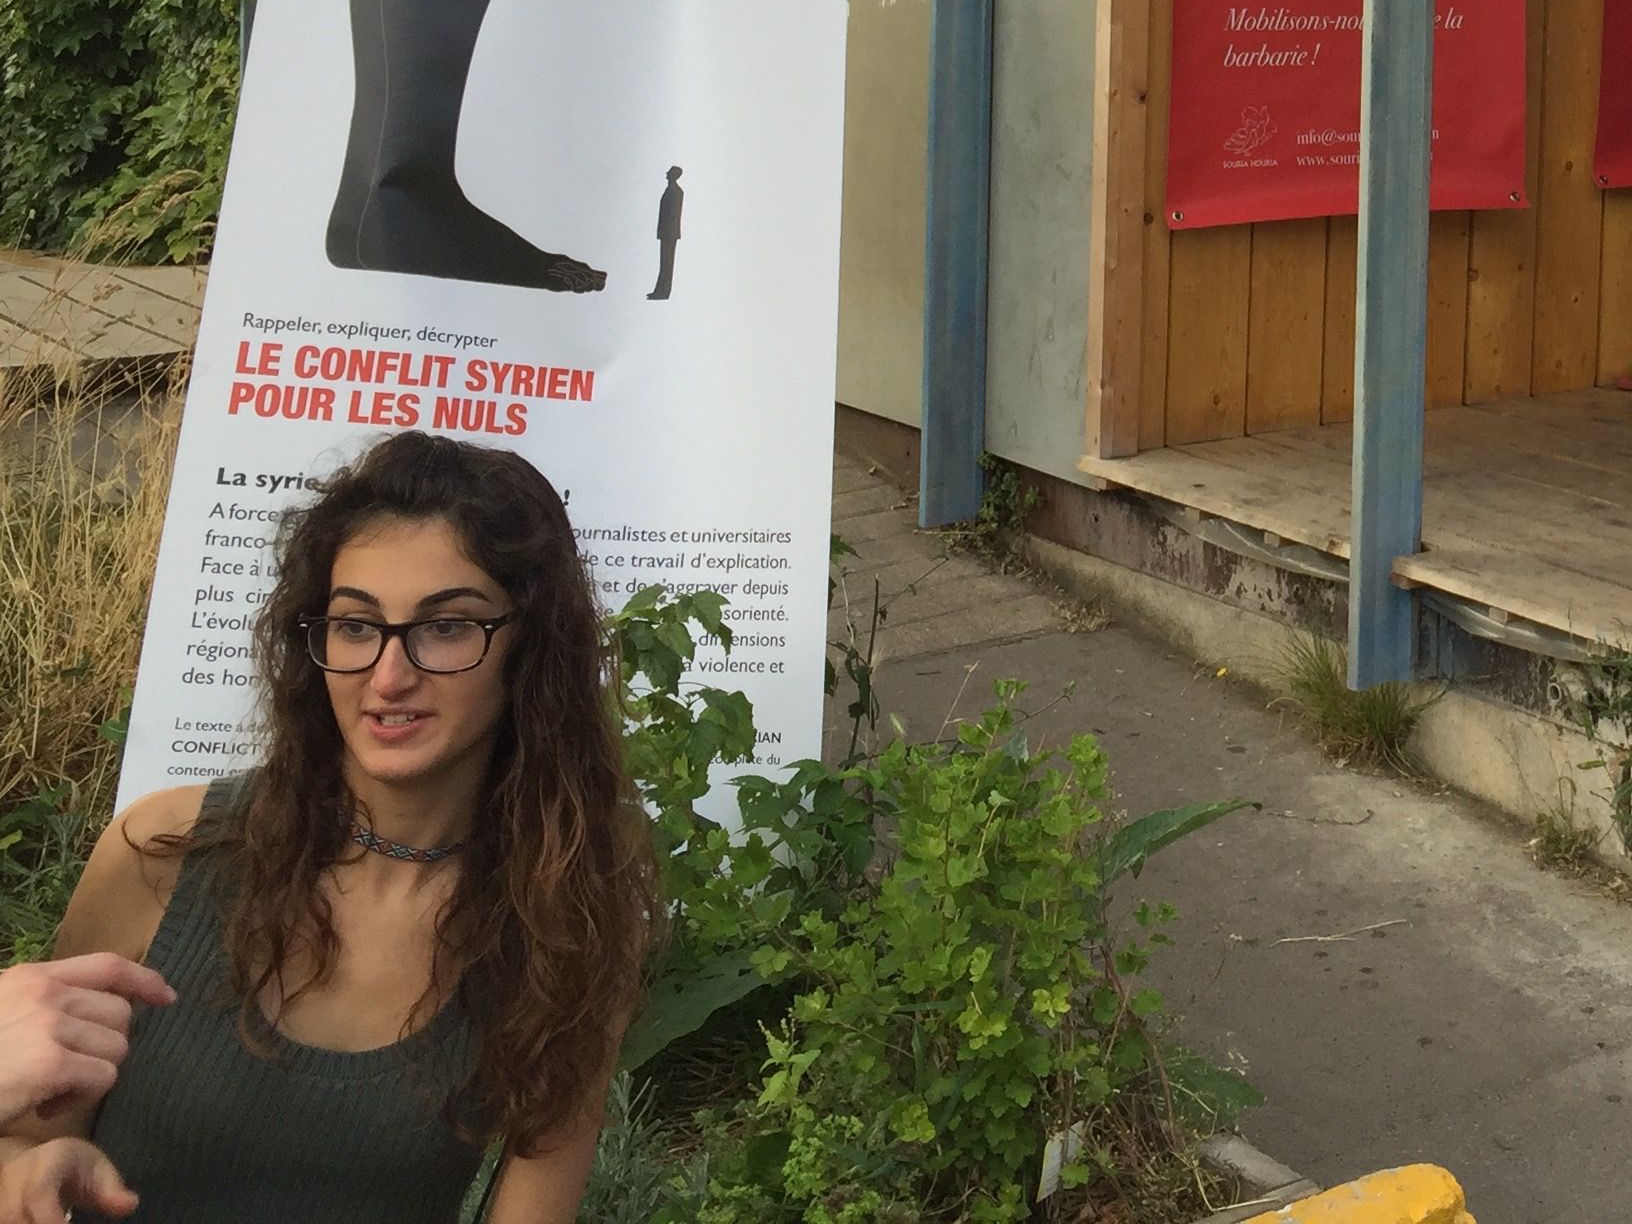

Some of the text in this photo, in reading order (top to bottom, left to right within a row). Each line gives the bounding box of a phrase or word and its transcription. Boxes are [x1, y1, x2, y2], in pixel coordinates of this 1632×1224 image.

[1444, 7, 1463, 30] la
[1223, 43, 1308, 67] barbarie
[243, 312, 498, 351] Rappeler, expliquer, décrypter
[235, 341, 595, 402] LE CONFLIT SYRIEN
[227, 382, 528, 436] POUR LES NULS
[216, 467, 247, 486] La
[255, 472, 318, 494] syrie
[208, 502, 792, 544] A force ournalistes et universitaires
[205, 529, 275, 549] franco-
[604, 554, 624, 567] ce
[631, 553, 684, 569] travail
[690, 553, 791, 573] d'explication.
[200, 556, 244, 575] Face
[249, 560, 260, 577] à
[602, 581, 619, 593] et
[743, 580, 789, 599] depuis
[195, 584, 234, 605] plus
[723, 606, 789, 621] sorienté.
[182, 667, 215, 684] des
[699, 657, 765, 673] violence
[769, 661, 785, 673] et
[174, 717, 191, 730] Le
[196, 721, 232, 732] texte
[171, 740, 262, 755] CONFLICT
[767, 753, 781, 765] du
[167, 765, 224, 777] contenu
